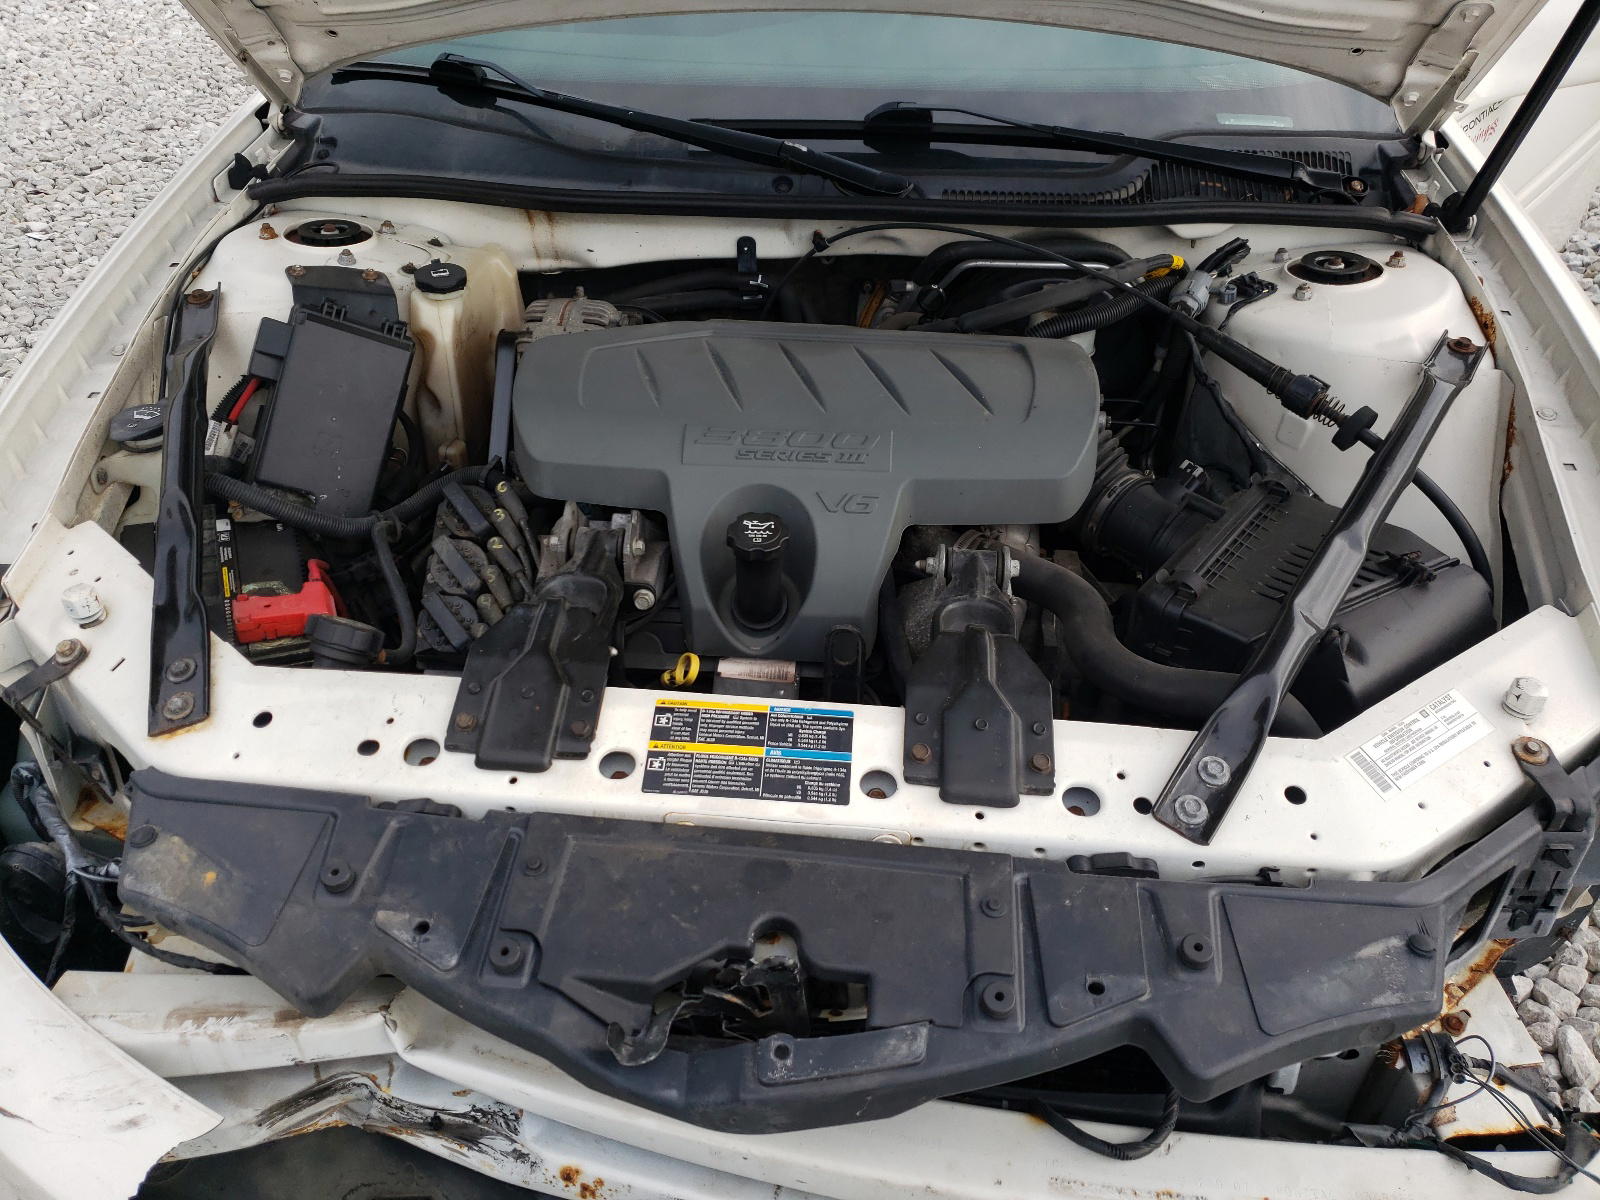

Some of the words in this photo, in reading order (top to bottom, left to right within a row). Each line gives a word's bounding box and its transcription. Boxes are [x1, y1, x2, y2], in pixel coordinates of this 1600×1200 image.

[1462, 100, 1503, 133] PONTIAC
[694, 425, 880, 450] 3800
[735, 448, 832, 463] SERIES
[815, 491, 880, 515] V6
[493, 508, 506, 522] 3
[490, 537, 504, 550] 2
[486, 568, 497, 583] 5
[1428, 693, 1453, 711] CATALYST
